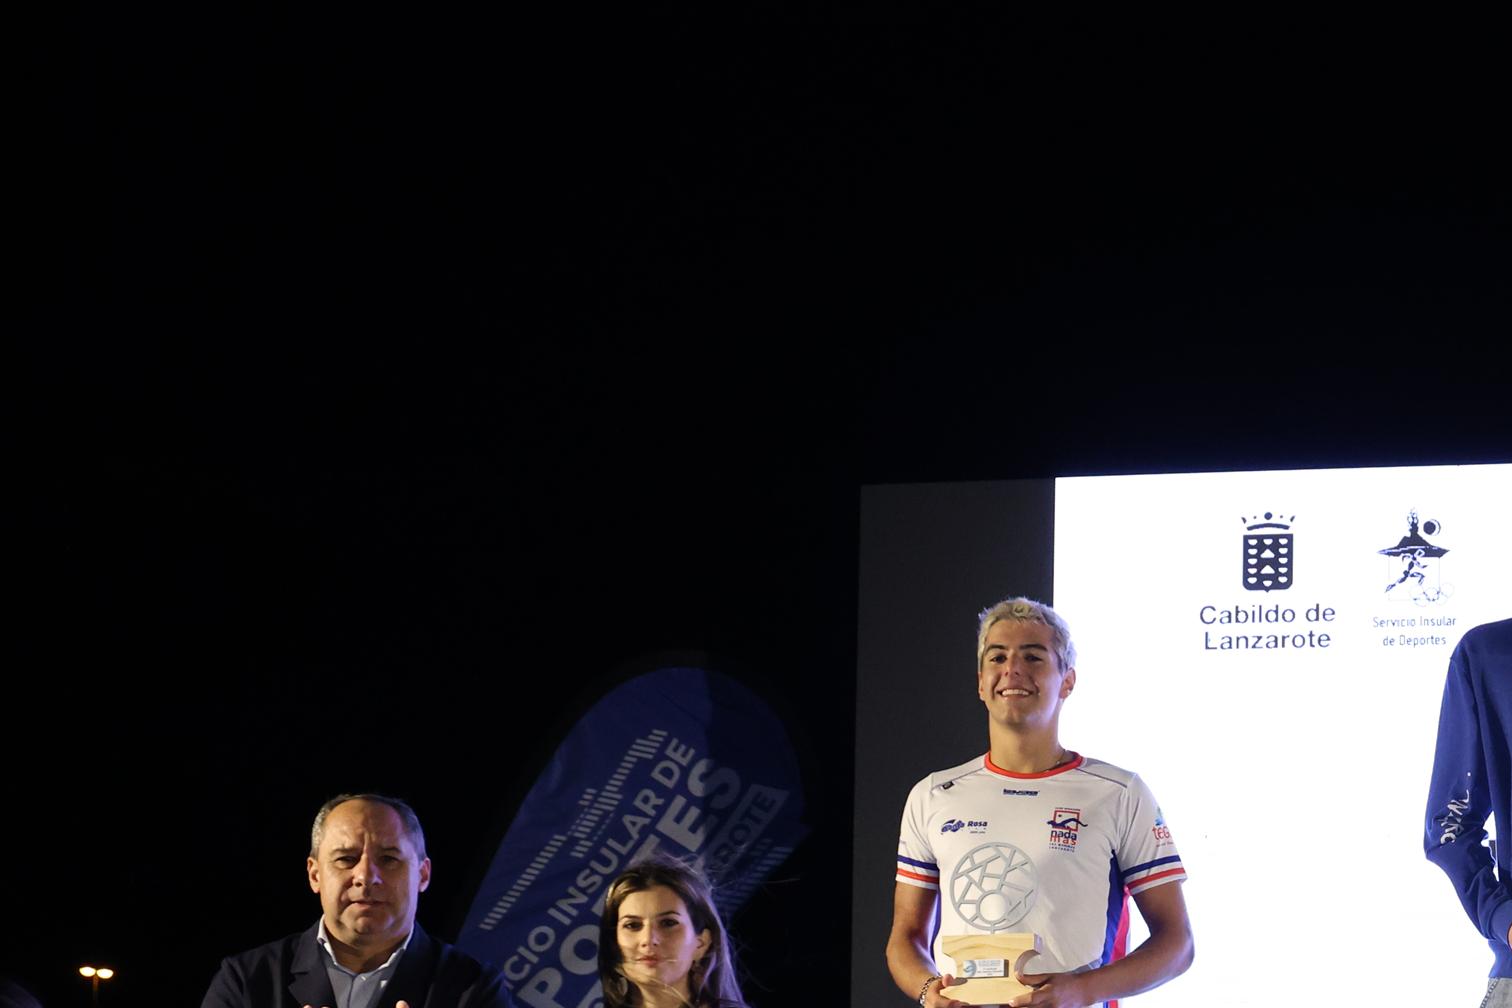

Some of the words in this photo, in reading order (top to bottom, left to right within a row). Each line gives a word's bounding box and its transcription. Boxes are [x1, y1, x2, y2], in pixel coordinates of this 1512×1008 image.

[1199, 604, 1296, 625] Cabildo
[1305, 603, 1336, 623] de
[1372, 616, 1416, 628] Servicio
[1419, 615, 1457, 627] Insular
[1204, 630, 1332, 650] Lanzarote
[1382, 635, 1396, 646] de
[547, 788, 665, 927] INSULAR
[650, 736, 695, 789] DE
